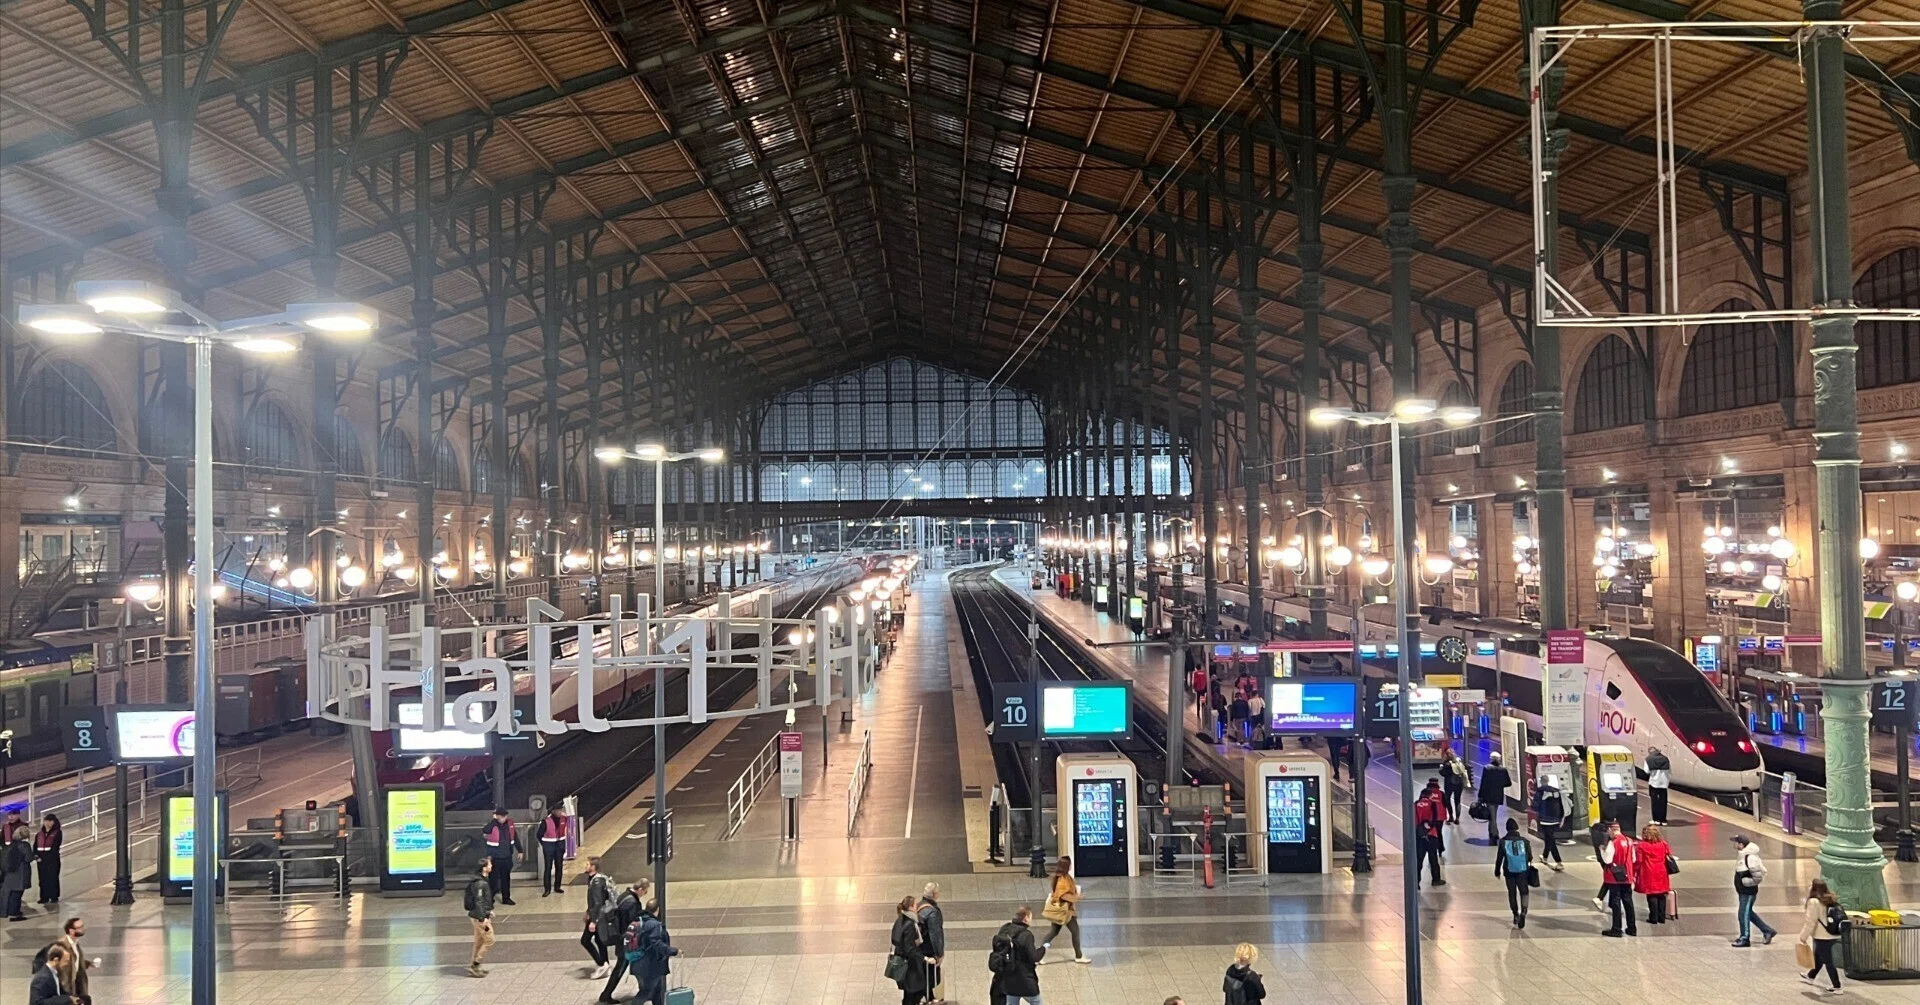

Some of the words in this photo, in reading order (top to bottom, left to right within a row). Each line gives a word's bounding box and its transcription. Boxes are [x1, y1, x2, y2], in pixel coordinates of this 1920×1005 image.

[370, 624, 611, 736] Hall
[659, 617, 707, 724] 1
[1881, 688, 1906, 707] 12
[1002, 705, 1027, 724] 10
[1375, 700, 1399, 718] 11
[78, 729, 92, 748] 8
